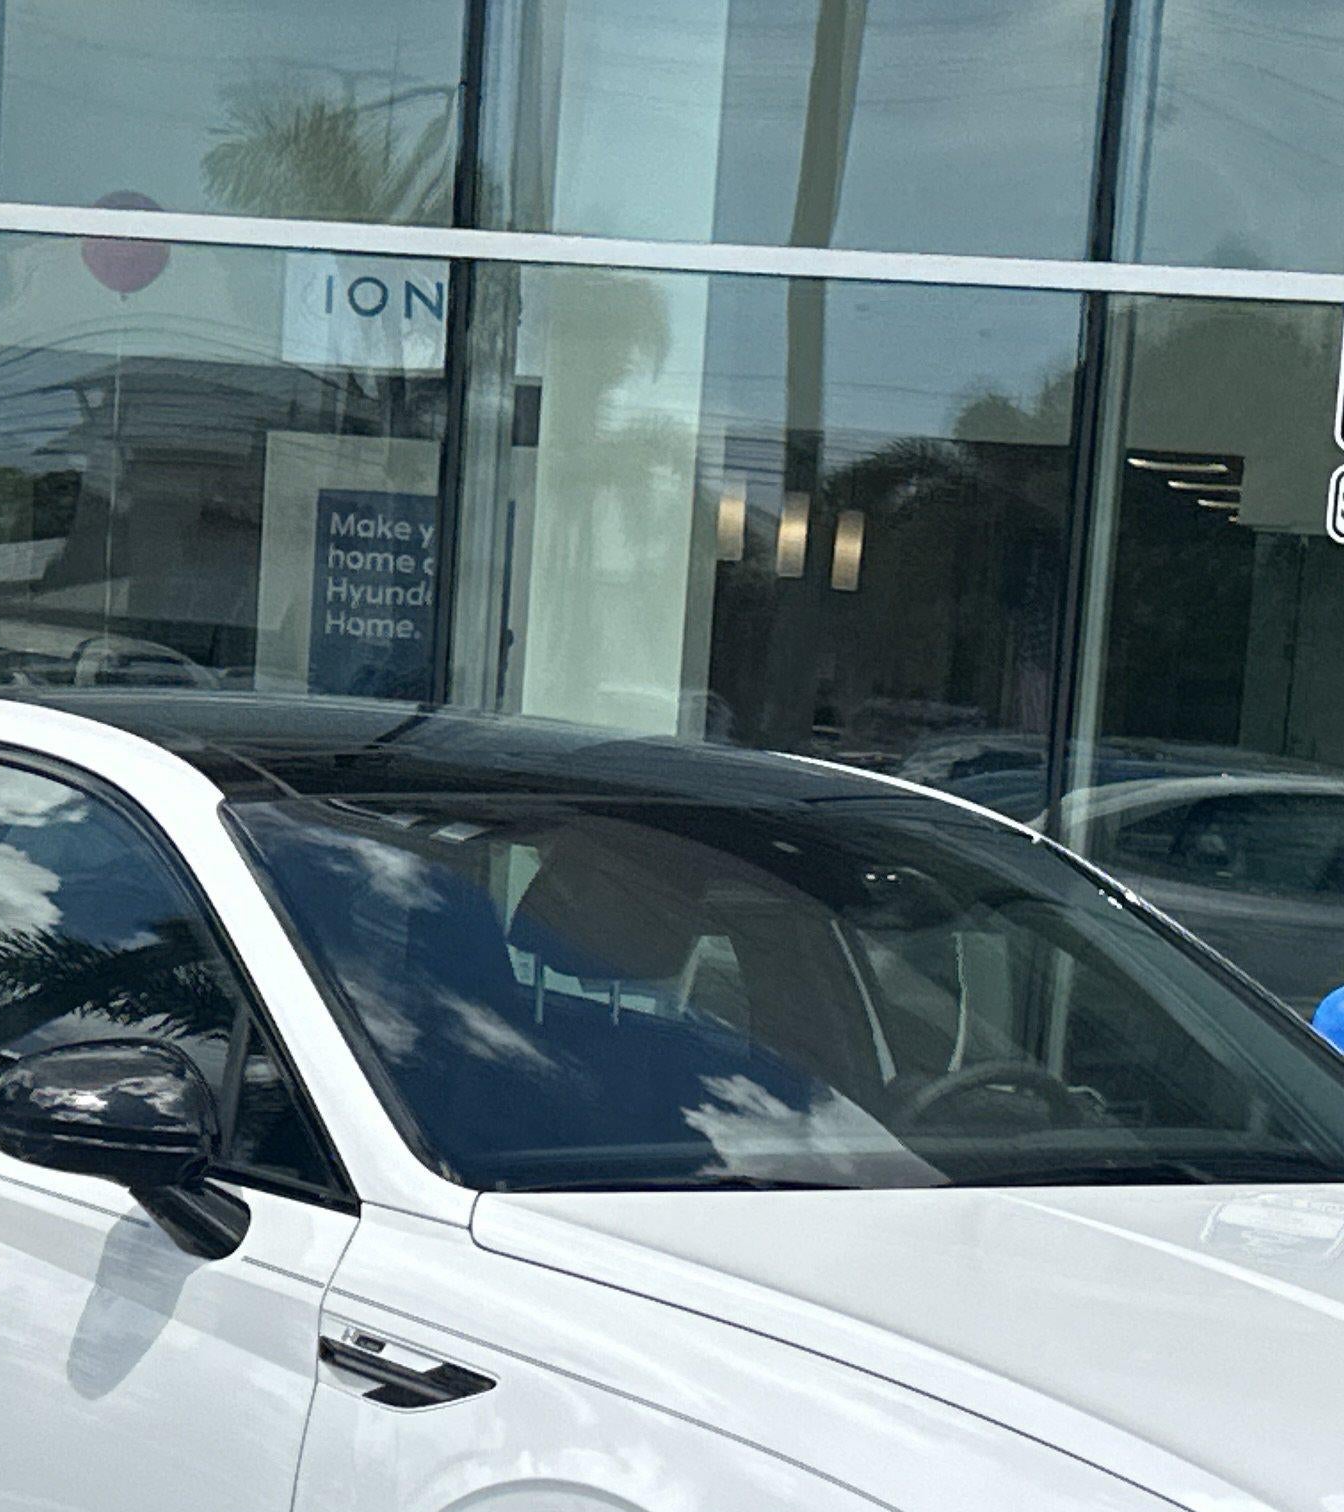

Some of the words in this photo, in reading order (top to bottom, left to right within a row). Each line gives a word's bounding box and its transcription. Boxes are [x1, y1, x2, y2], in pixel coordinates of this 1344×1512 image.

[330, 512, 412, 541] Make
[328, 543, 415, 574] home
[324, 610, 421, 640] Home.
